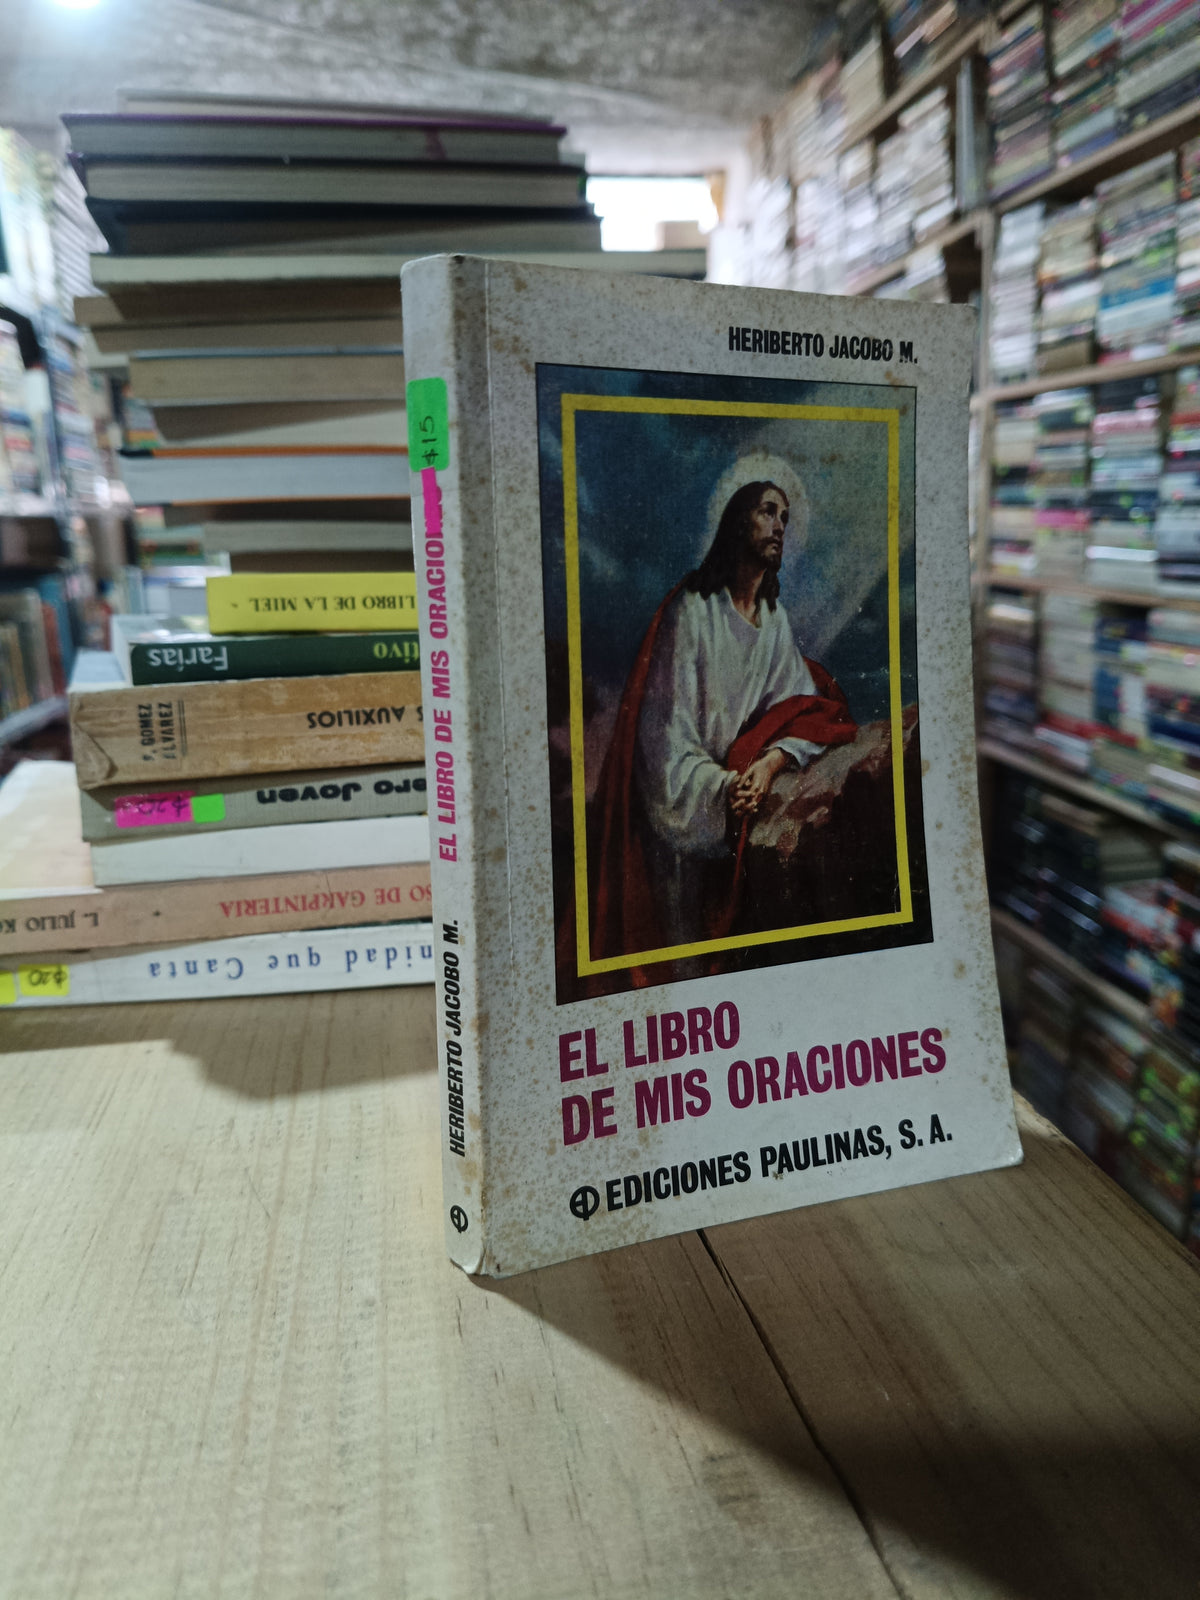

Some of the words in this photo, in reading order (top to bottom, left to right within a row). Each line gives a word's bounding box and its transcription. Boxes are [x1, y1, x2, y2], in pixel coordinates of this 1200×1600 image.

[728, 326, 824, 357] HERIBERTO
[829, 335, 893, 362] JACOBO
[899, 341, 918, 364] M.
[419, 416, 439, 466] $15
[424, 486, 450, 639] ORACIO
[249, 597, 297, 612] MIEL
[304, 596, 328, 611] LA
[334, 596, 356, 610] DE
[361, 595, 415, 611] LIBRO
[148, 645, 229, 672] Farías
[430, 650, 451, 699] MIS
[137, 703, 156, 747] GOMEZ
[306, 706, 405, 729] AUXILIOS
[433, 709, 453, 743] DE
[256, 782, 362, 804] Joven
[373, 778, 427, 795] ero
[435, 751, 456, 824] LIBRO
[439, 834, 458, 862] EL
[374, 886, 400, 906] DE
[25, 910, 76, 932] JULIO
[83, 911, 100, 927] L.
[442, 919, 459, 945] M.
[149, 956, 244, 980] Canta
[267, 946, 321, 969] que
[345, 944, 433, 973] nidad
[443, 951, 463, 1036] JACOBO
[558, 1028, 609, 1083] EL
[623, 1000, 740, 1069] LIBRO
[446, 1041, 465, 1157] HERIBERTO
[561, 1086, 619, 1146] DE
[635, 1068, 712, 1129] MIS
[727, 1027, 947, 1109] ORACIONES
[605, 1150, 752, 1212] EDICIONES
[760, 1124, 892, 1178] PAULINAS,
[898, 1118, 923, 1150] S.
[929, 1113, 953, 1144] A.
